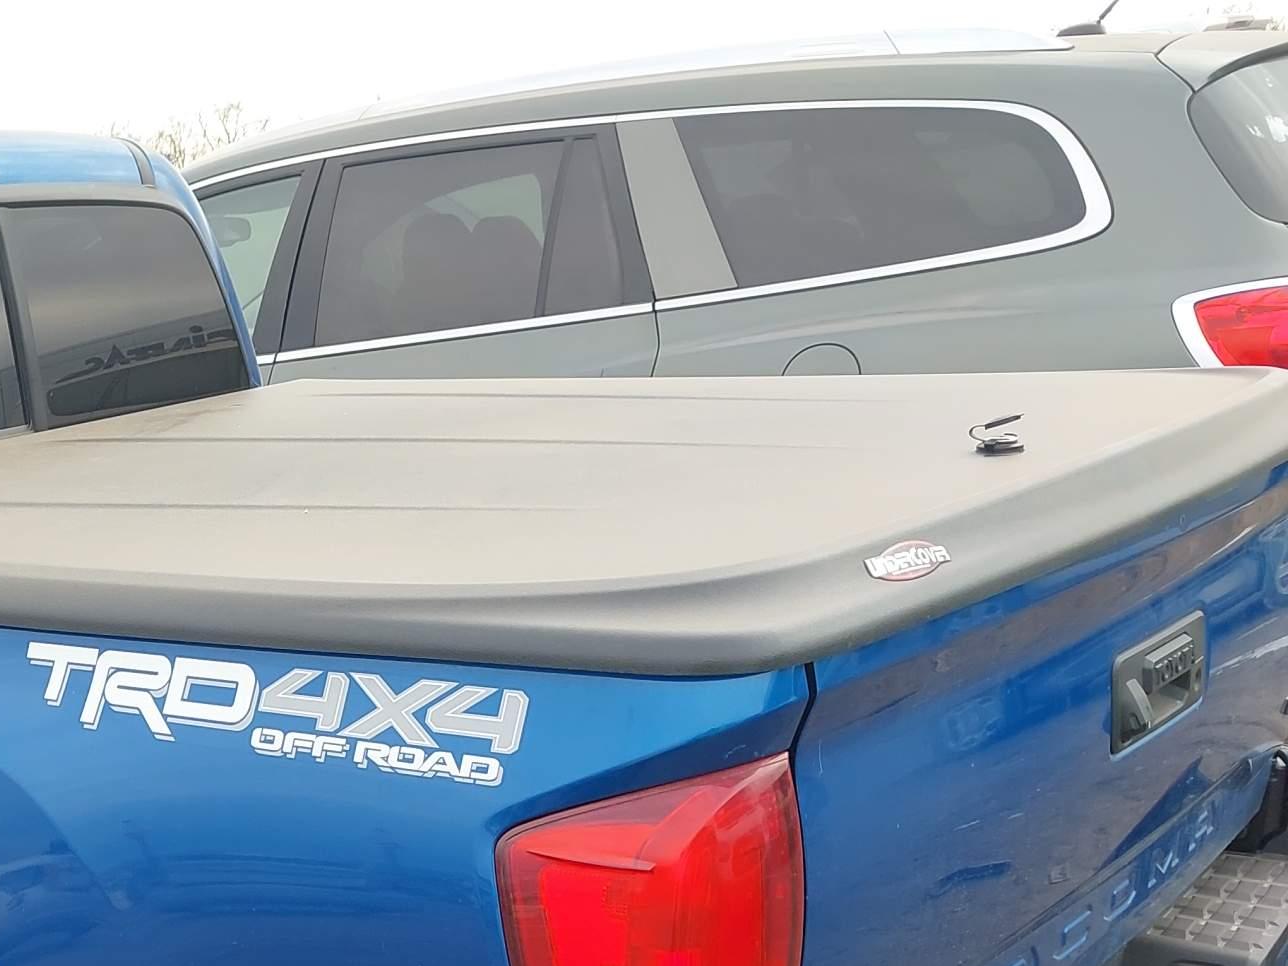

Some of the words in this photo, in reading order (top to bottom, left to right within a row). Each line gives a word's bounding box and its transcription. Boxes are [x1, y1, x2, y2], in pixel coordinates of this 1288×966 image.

[26, 641, 259, 742] TRD
[250, 727, 350, 763] OFF
[353, 740, 504, 787] ROAD
